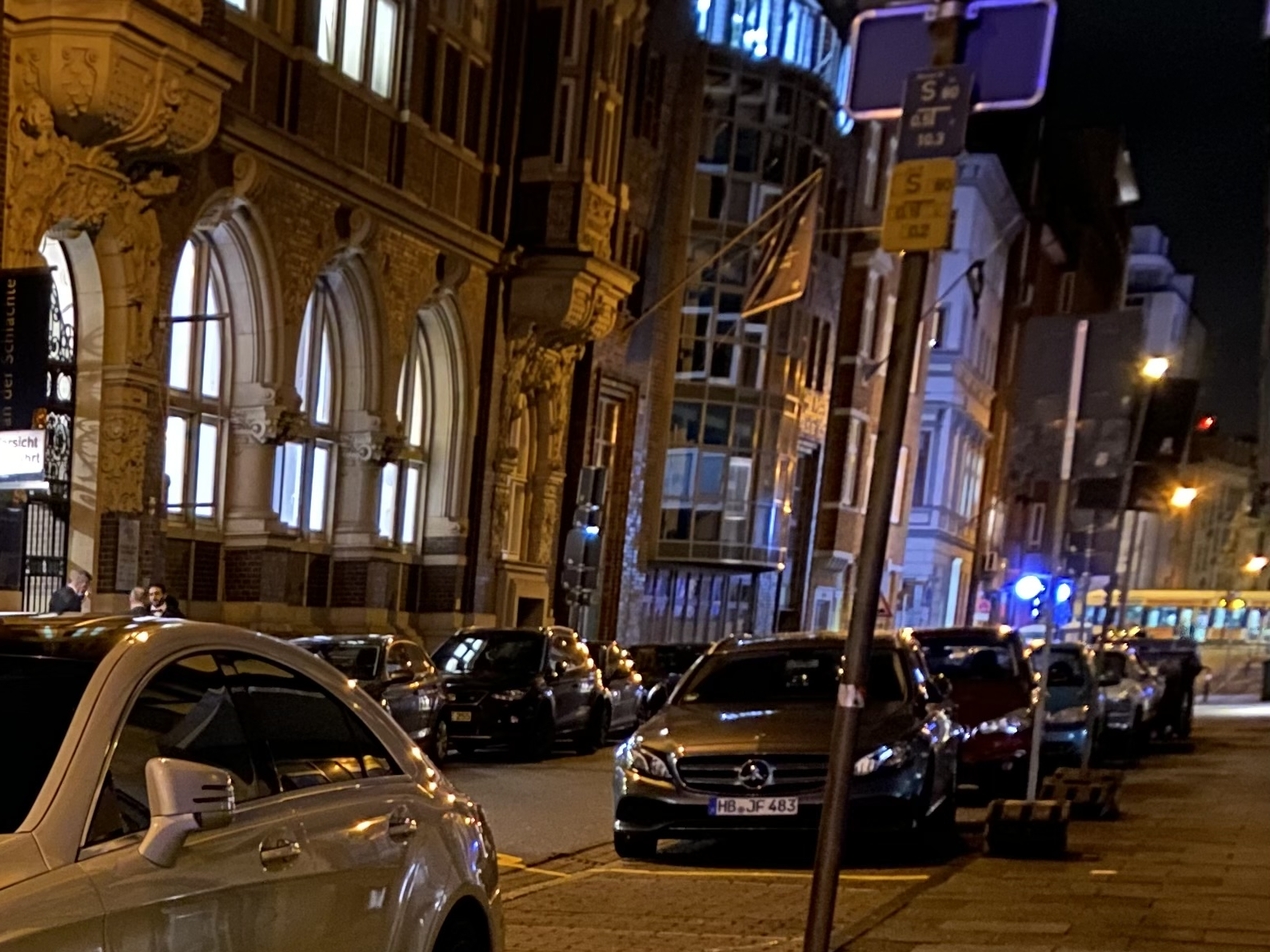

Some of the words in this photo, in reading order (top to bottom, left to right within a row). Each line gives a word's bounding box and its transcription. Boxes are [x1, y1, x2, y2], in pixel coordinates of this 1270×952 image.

[920, 81, 936, 101] S
[906, 173, 922, 194] S
[718, 799, 735, 813] HB
[746, 799, 764, 813] JF
[769, 799, 796, 812] 483
